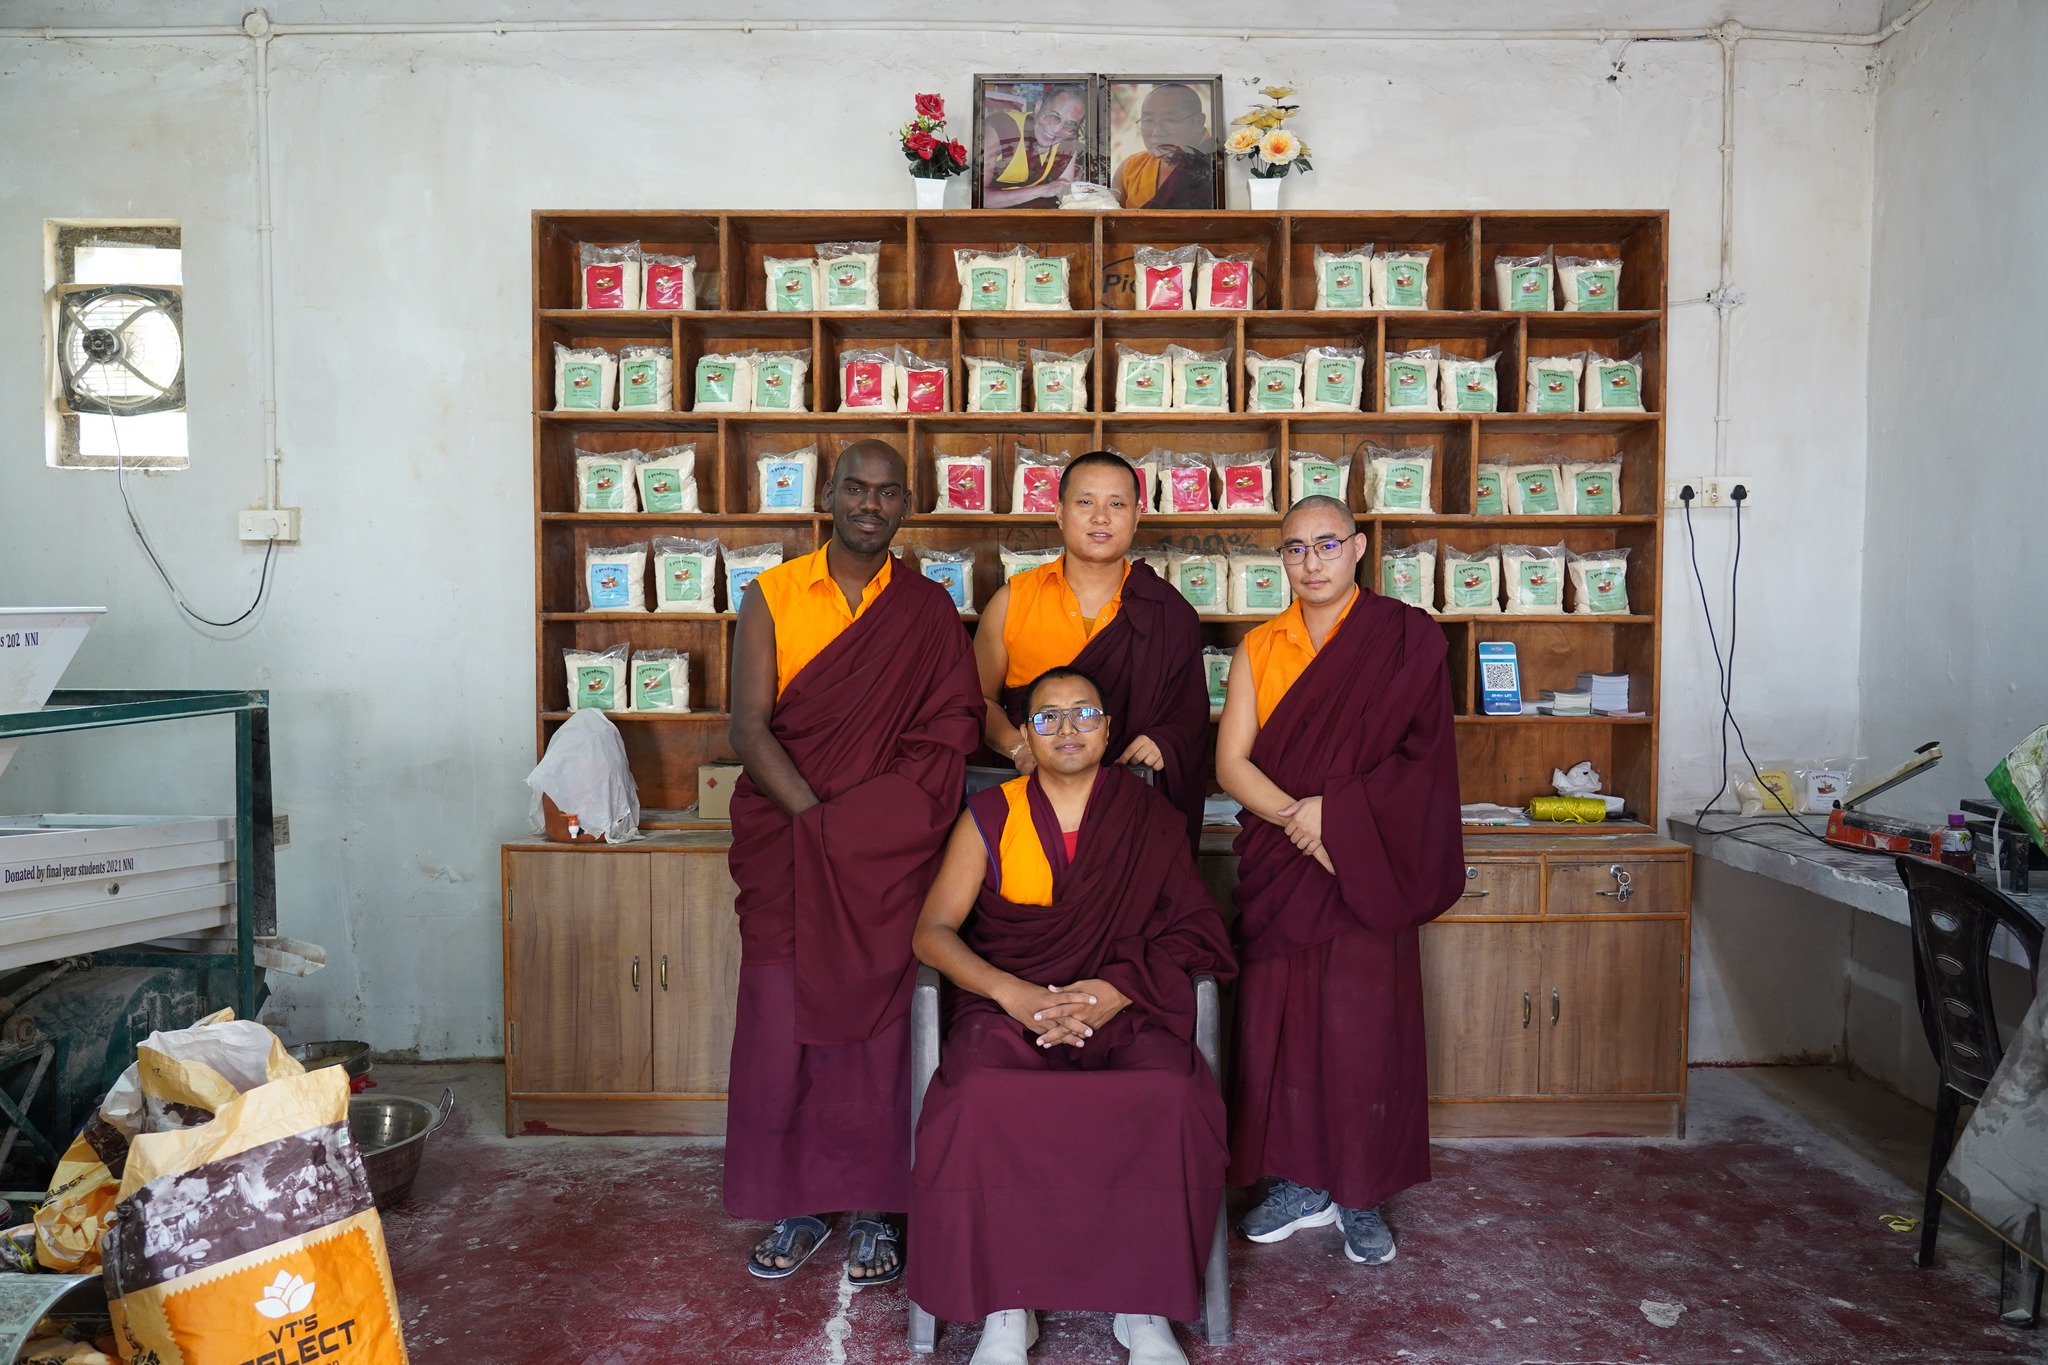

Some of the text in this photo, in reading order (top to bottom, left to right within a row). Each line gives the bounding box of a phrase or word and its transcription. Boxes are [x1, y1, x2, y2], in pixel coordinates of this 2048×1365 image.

[25, 631, 39, 646] NNI
[5, 857, 134, 883] Donated by final year students 2021 NNI
[44, 1174, 86, 1200] ELECT
[269, 1313, 318, 1344] VT'S
